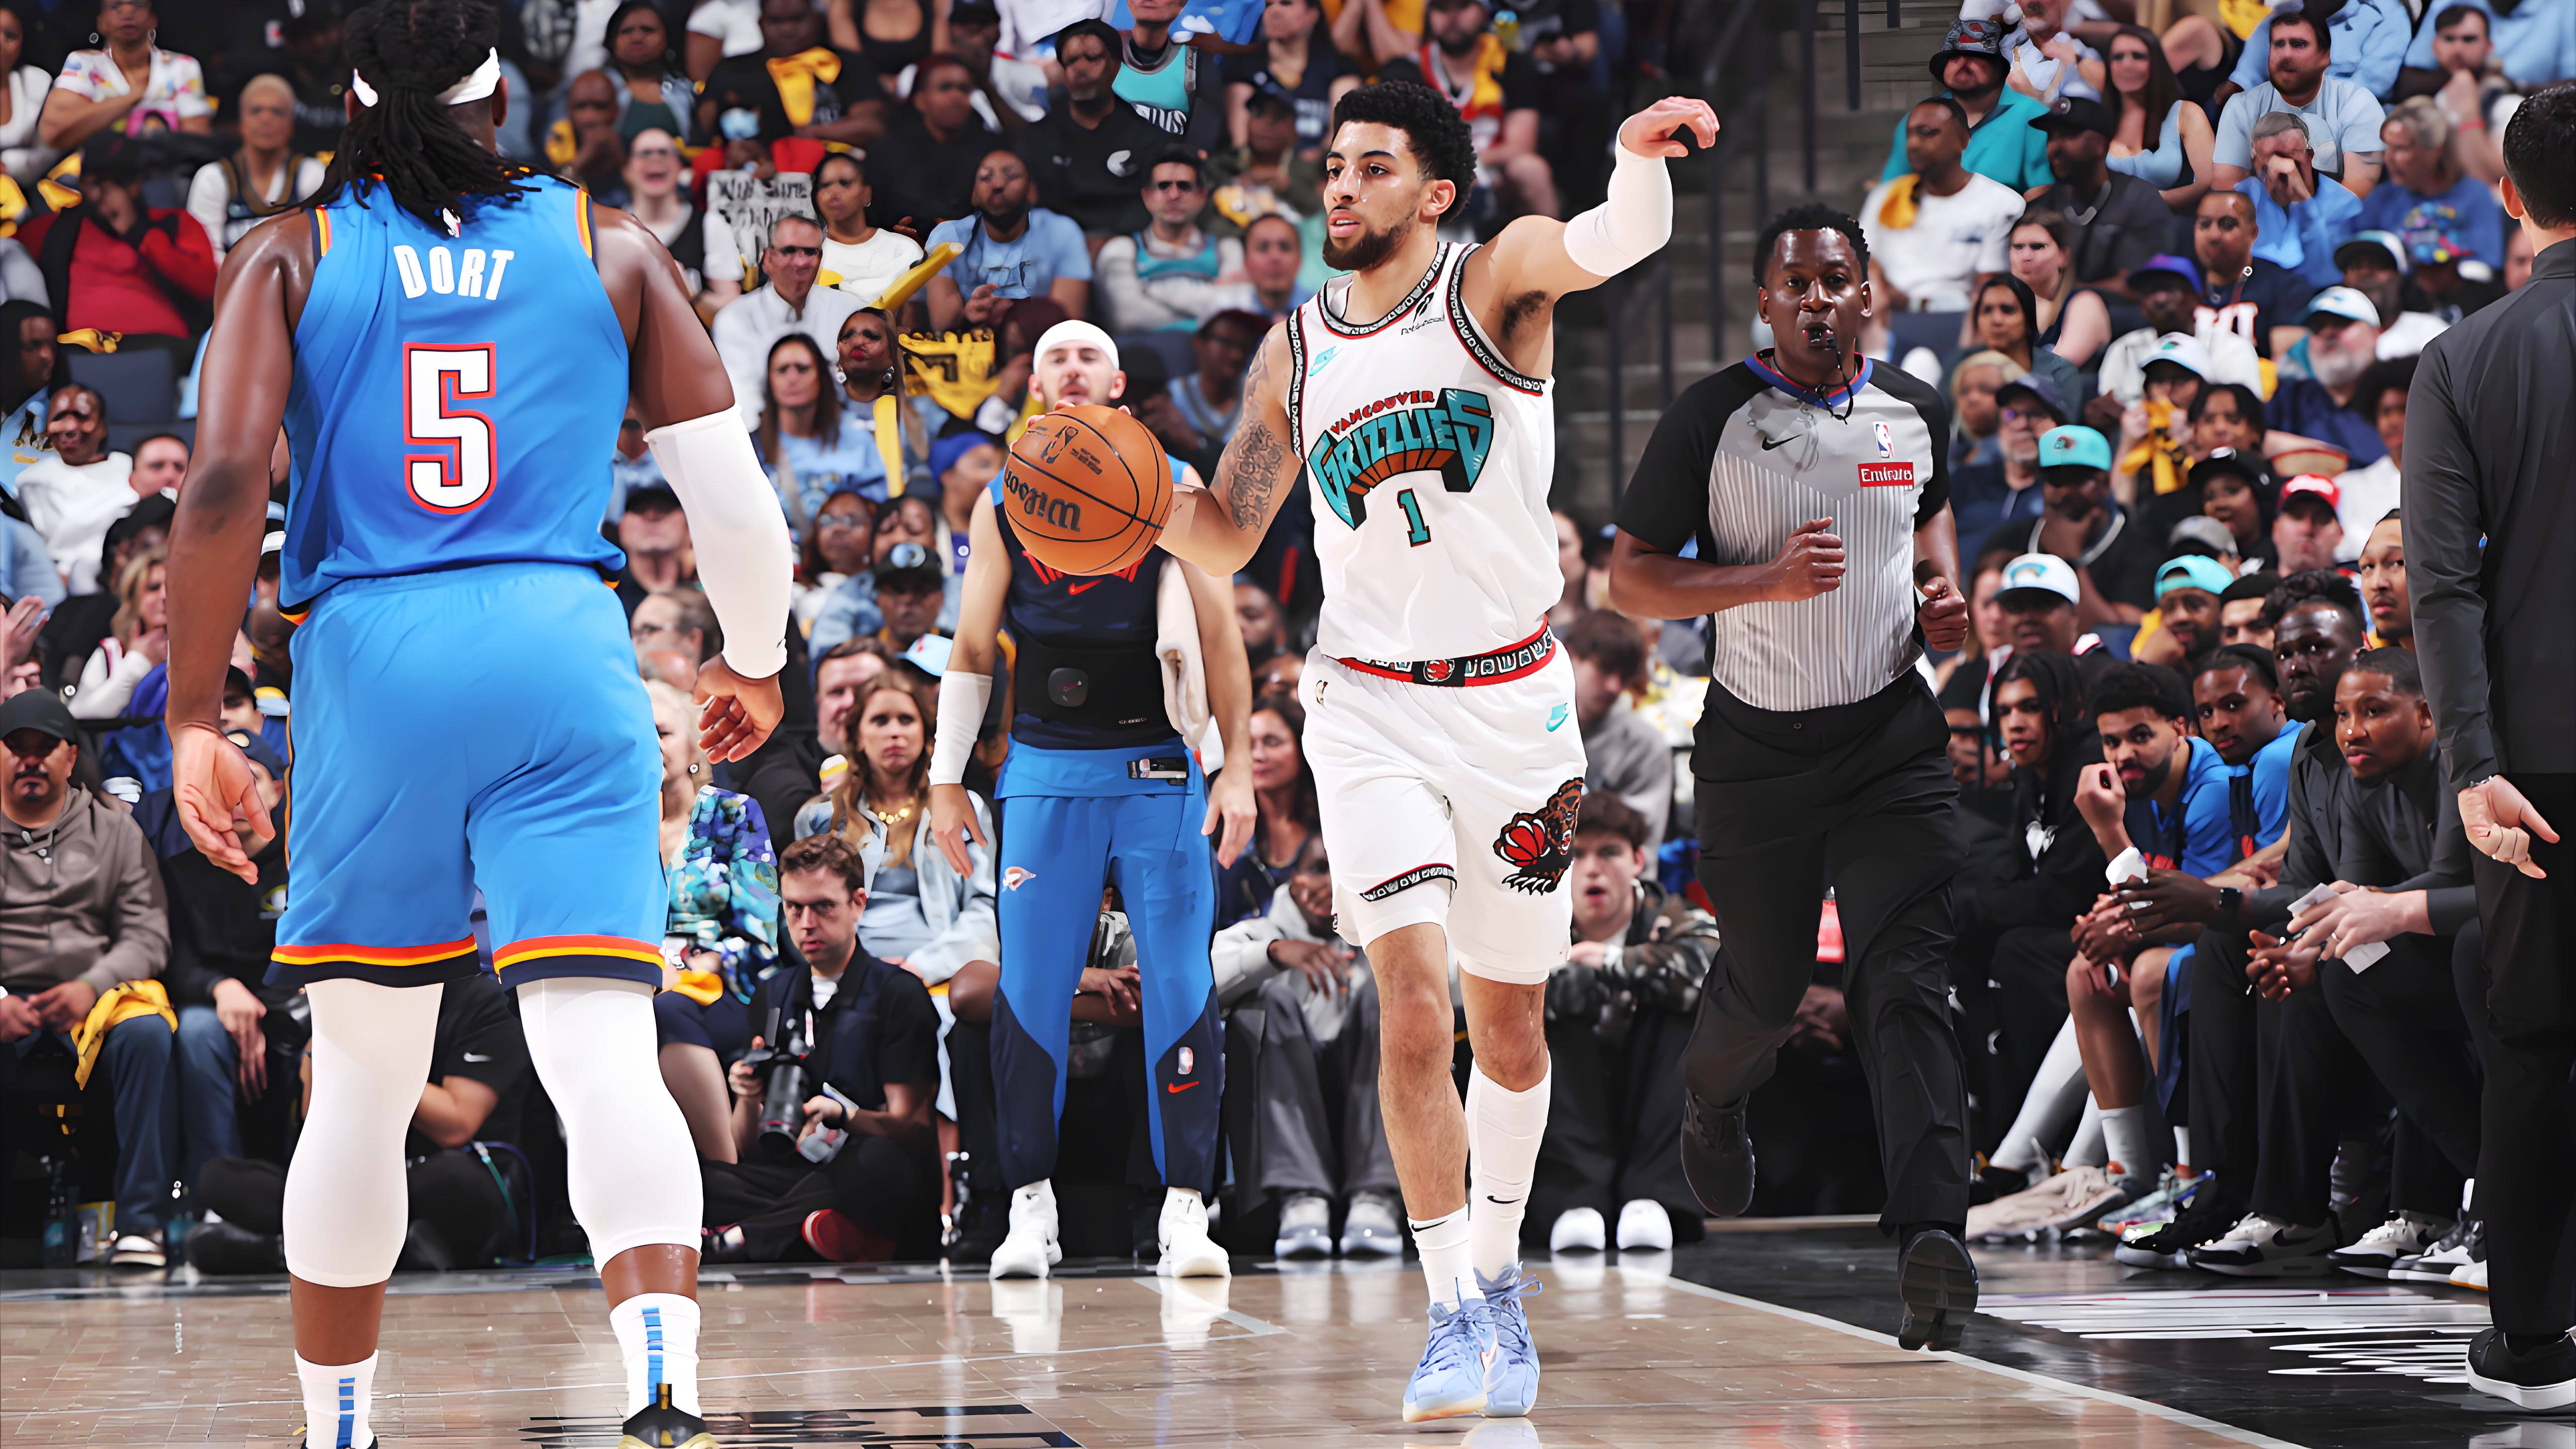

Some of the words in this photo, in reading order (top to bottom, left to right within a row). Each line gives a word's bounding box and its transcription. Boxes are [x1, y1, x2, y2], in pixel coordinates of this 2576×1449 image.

[393, 245, 515, 300] DORT
[403, 342, 498, 515] 5
[1330, 390, 1435, 435] VANCOUVER
[1307, 387, 1494, 531] GRIZZLIES
[1397, 488, 1432, 547] 1
